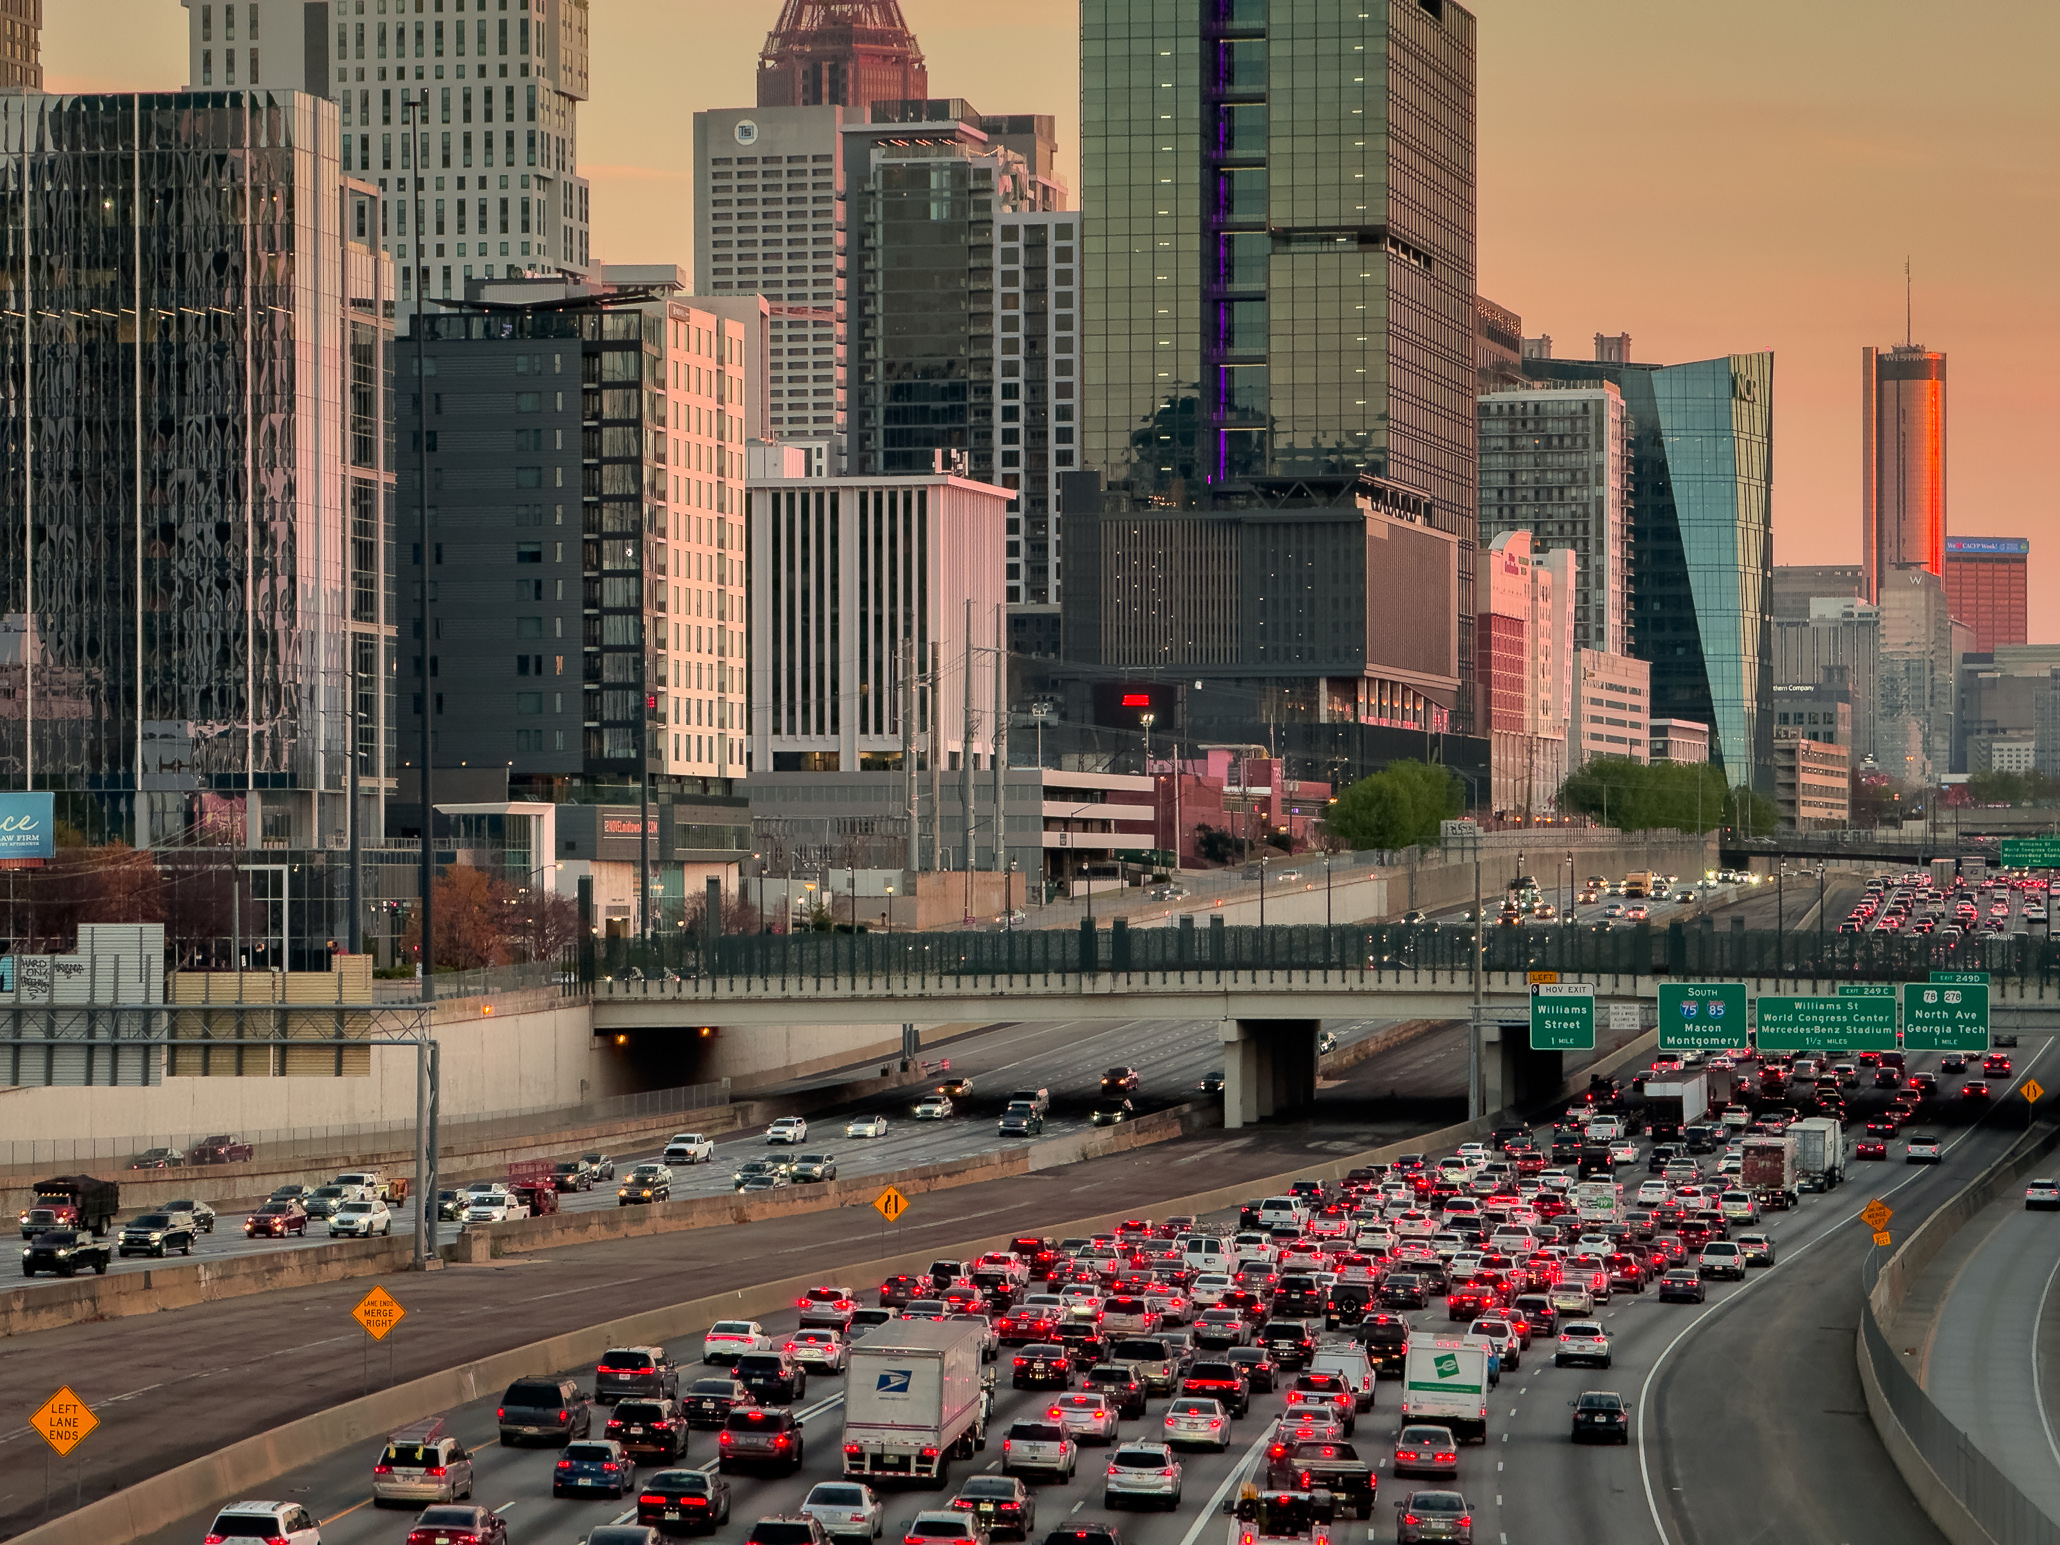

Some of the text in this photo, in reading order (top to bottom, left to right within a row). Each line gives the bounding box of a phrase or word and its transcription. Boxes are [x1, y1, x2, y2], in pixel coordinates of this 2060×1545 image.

[1731, 372, 1757, 402] NCR
[1910, 576, 1922, 584] W
[1925, 993, 1961, 1001] 78 278
[1538, 1005, 1587, 1014] Williams
[1682, 1005, 1724, 1015] 75 85
[1794, 1002, 1859, 1010] Williams St
[1764, 1013, 1889, 1023] World Congress Center
[1915, 1010, 1977, 1019] North Ave
[1544, 1020, 1581, 1029] Street
[1684, 1023, 1722, 1032] Macon
[1761, 1025, 1892, 1034] Mercedes-Benz Stadium
[1907, 1024, 1985, 1035] Georgia Tech
[1667, 1036, 1739, 1047] Montgomery
[364, 1309, 393, 1317] MERGE
[366, 1319, 392, 1327] RIGHT
[51, 1404, 78, 1414] LEFT
[49, 1417, 79, 1427] LANE
[49, 1430, 79, 1440] ENDS
